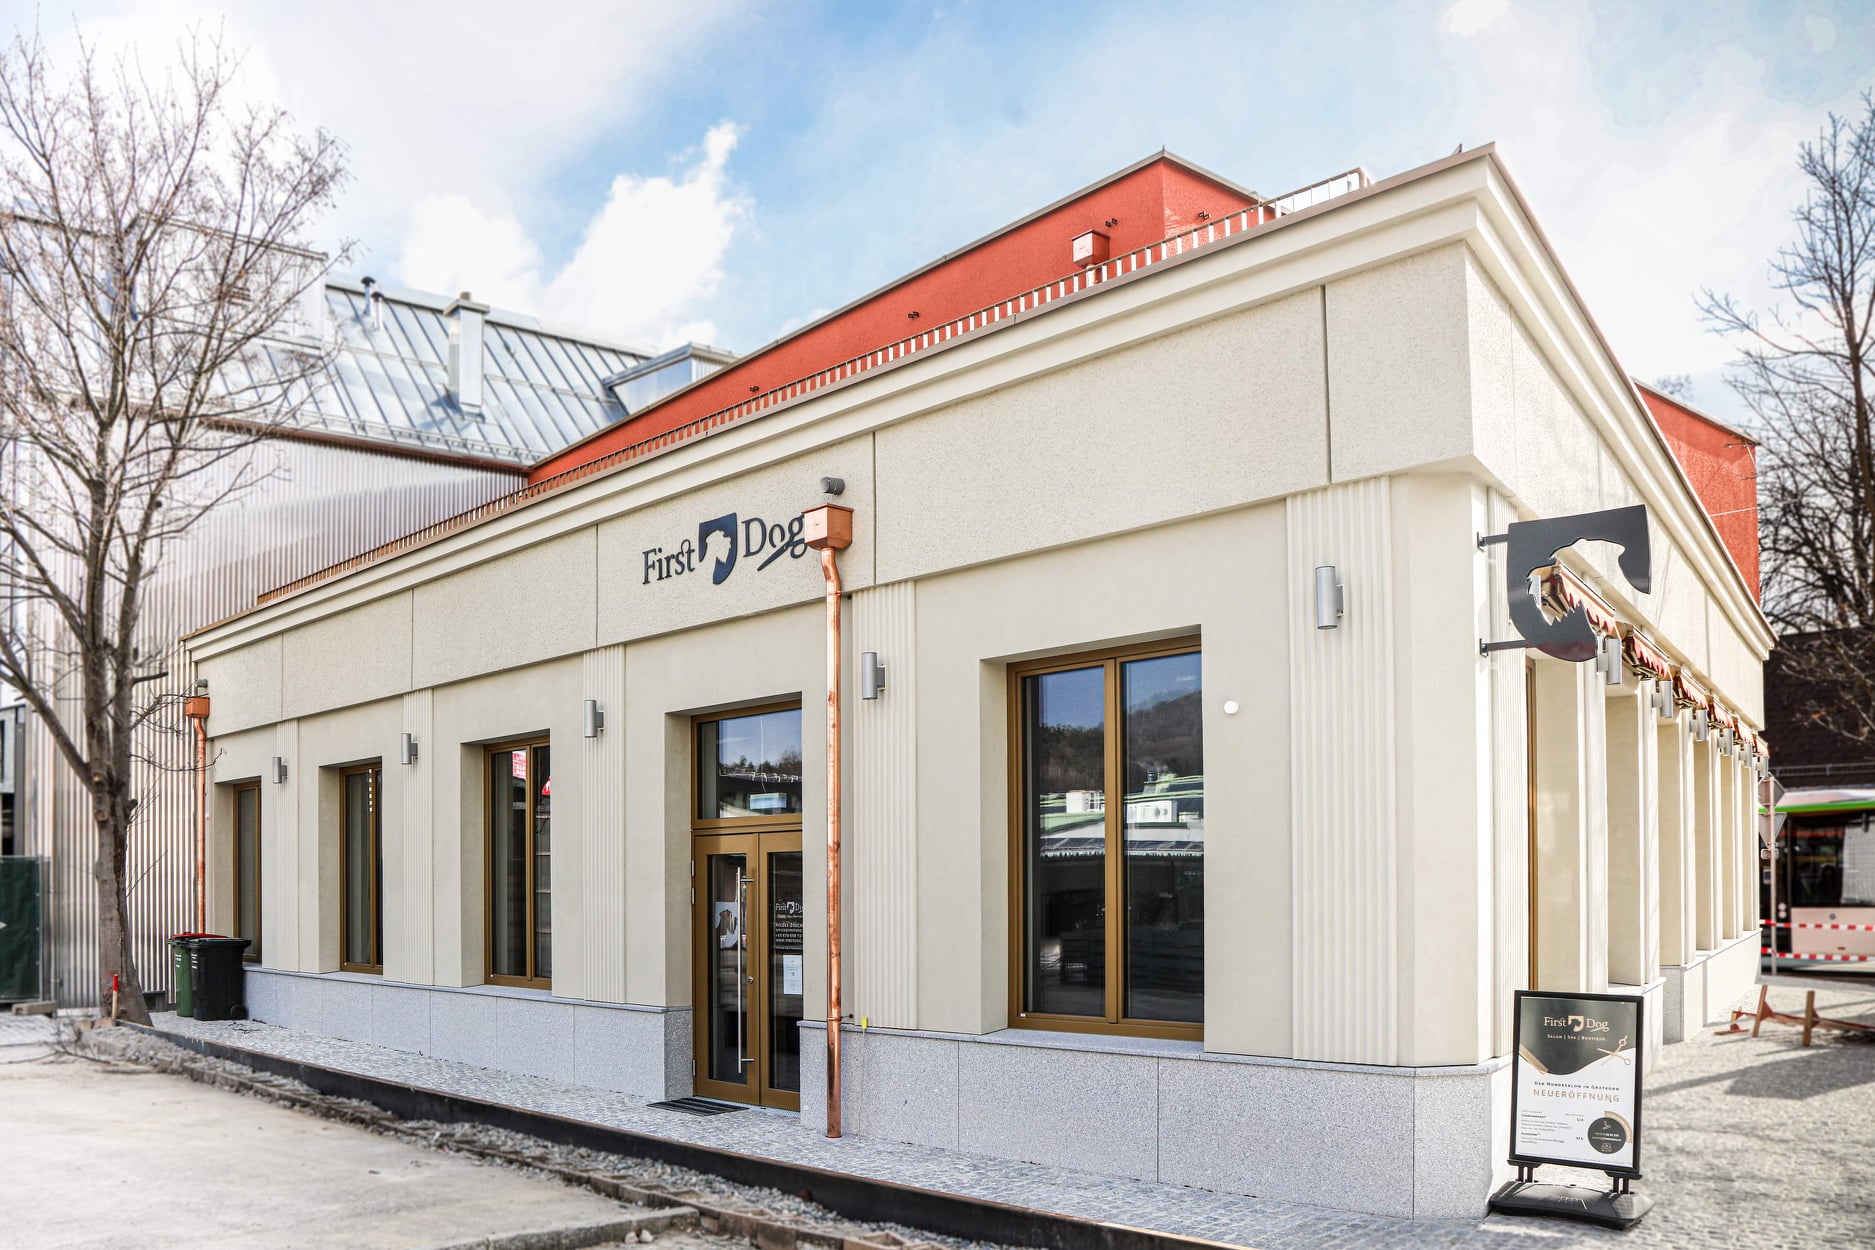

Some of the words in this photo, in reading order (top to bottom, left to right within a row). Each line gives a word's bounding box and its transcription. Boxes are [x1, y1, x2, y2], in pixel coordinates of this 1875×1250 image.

[642, 539, 696, 585] First
[741, 514, 808, 572] Dog
[1543, 1016, 1567, 1027] First
[1586, 1018, 1610, 1033] Dog
[1533, 1089, 1620, 1103] NEUERÖFFNUNG
